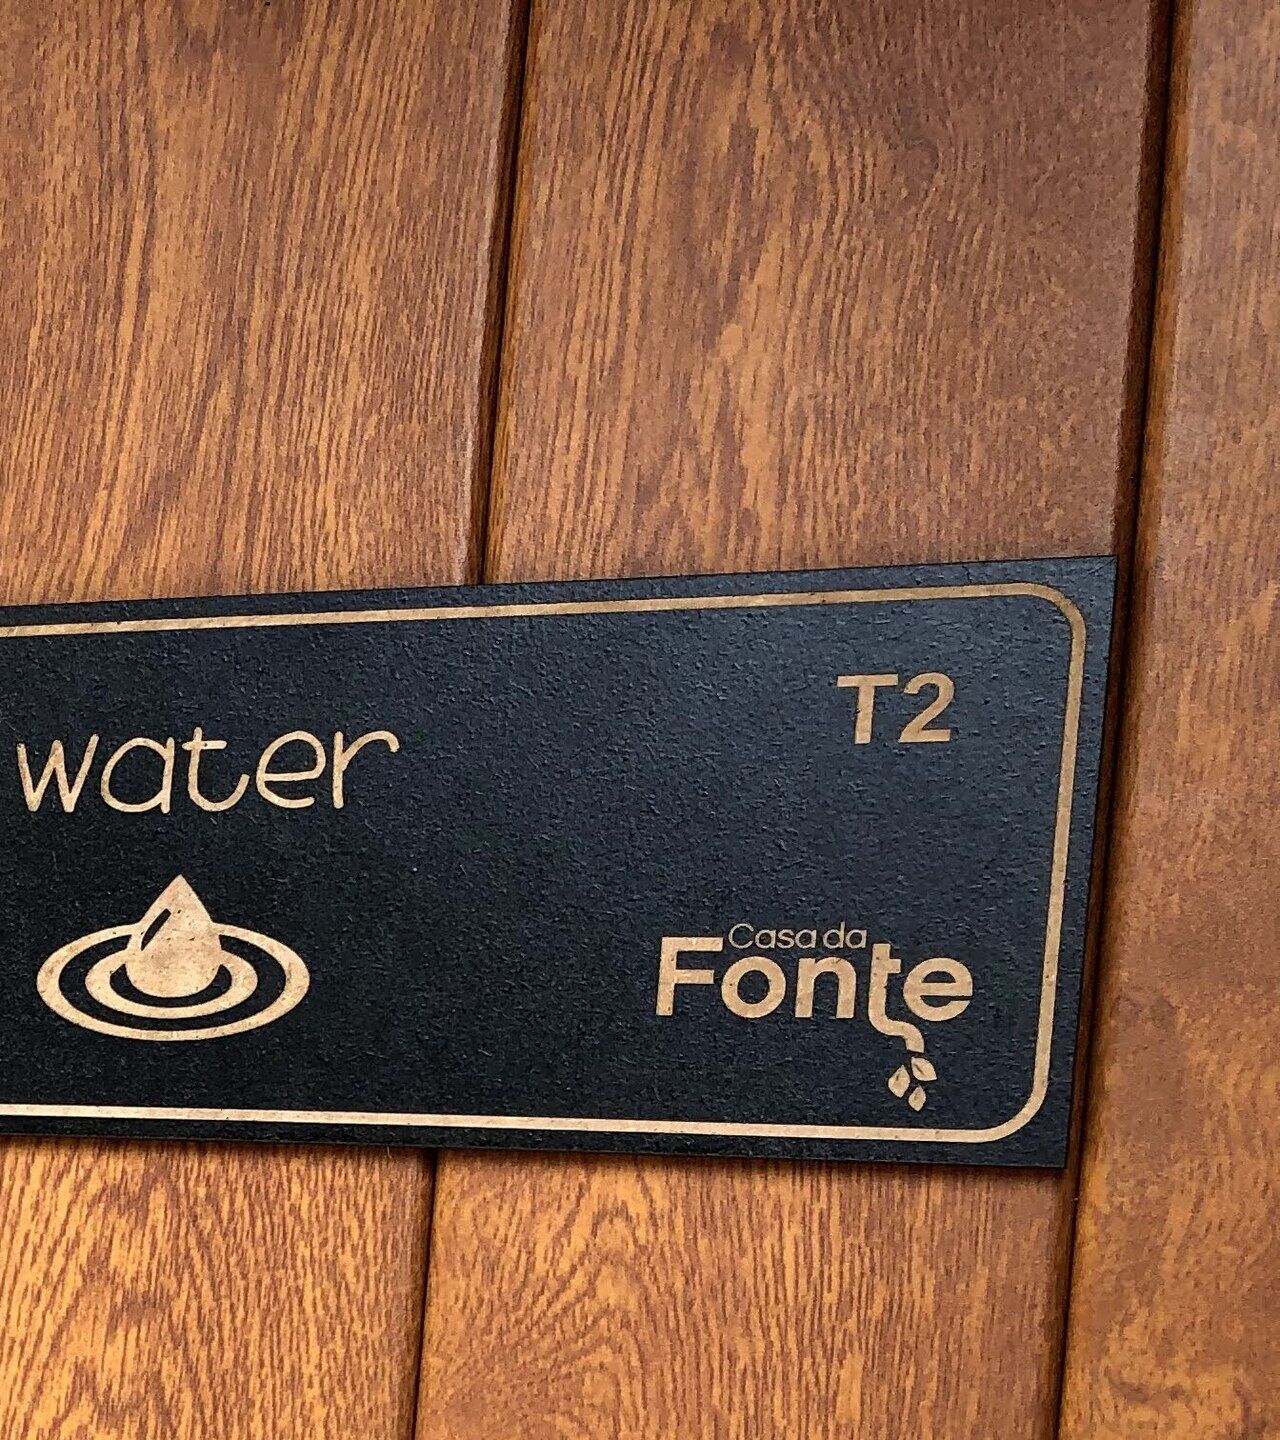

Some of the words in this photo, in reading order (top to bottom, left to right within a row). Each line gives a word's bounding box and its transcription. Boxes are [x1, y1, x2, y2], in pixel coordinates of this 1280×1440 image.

[837, 672, 955, 744] T2
[16, 726, 401, 814] water
[728, 923, 817, 949] Casa
[822, 922, 867, 949] da
[656, 936, 974, 1053] Fonte
